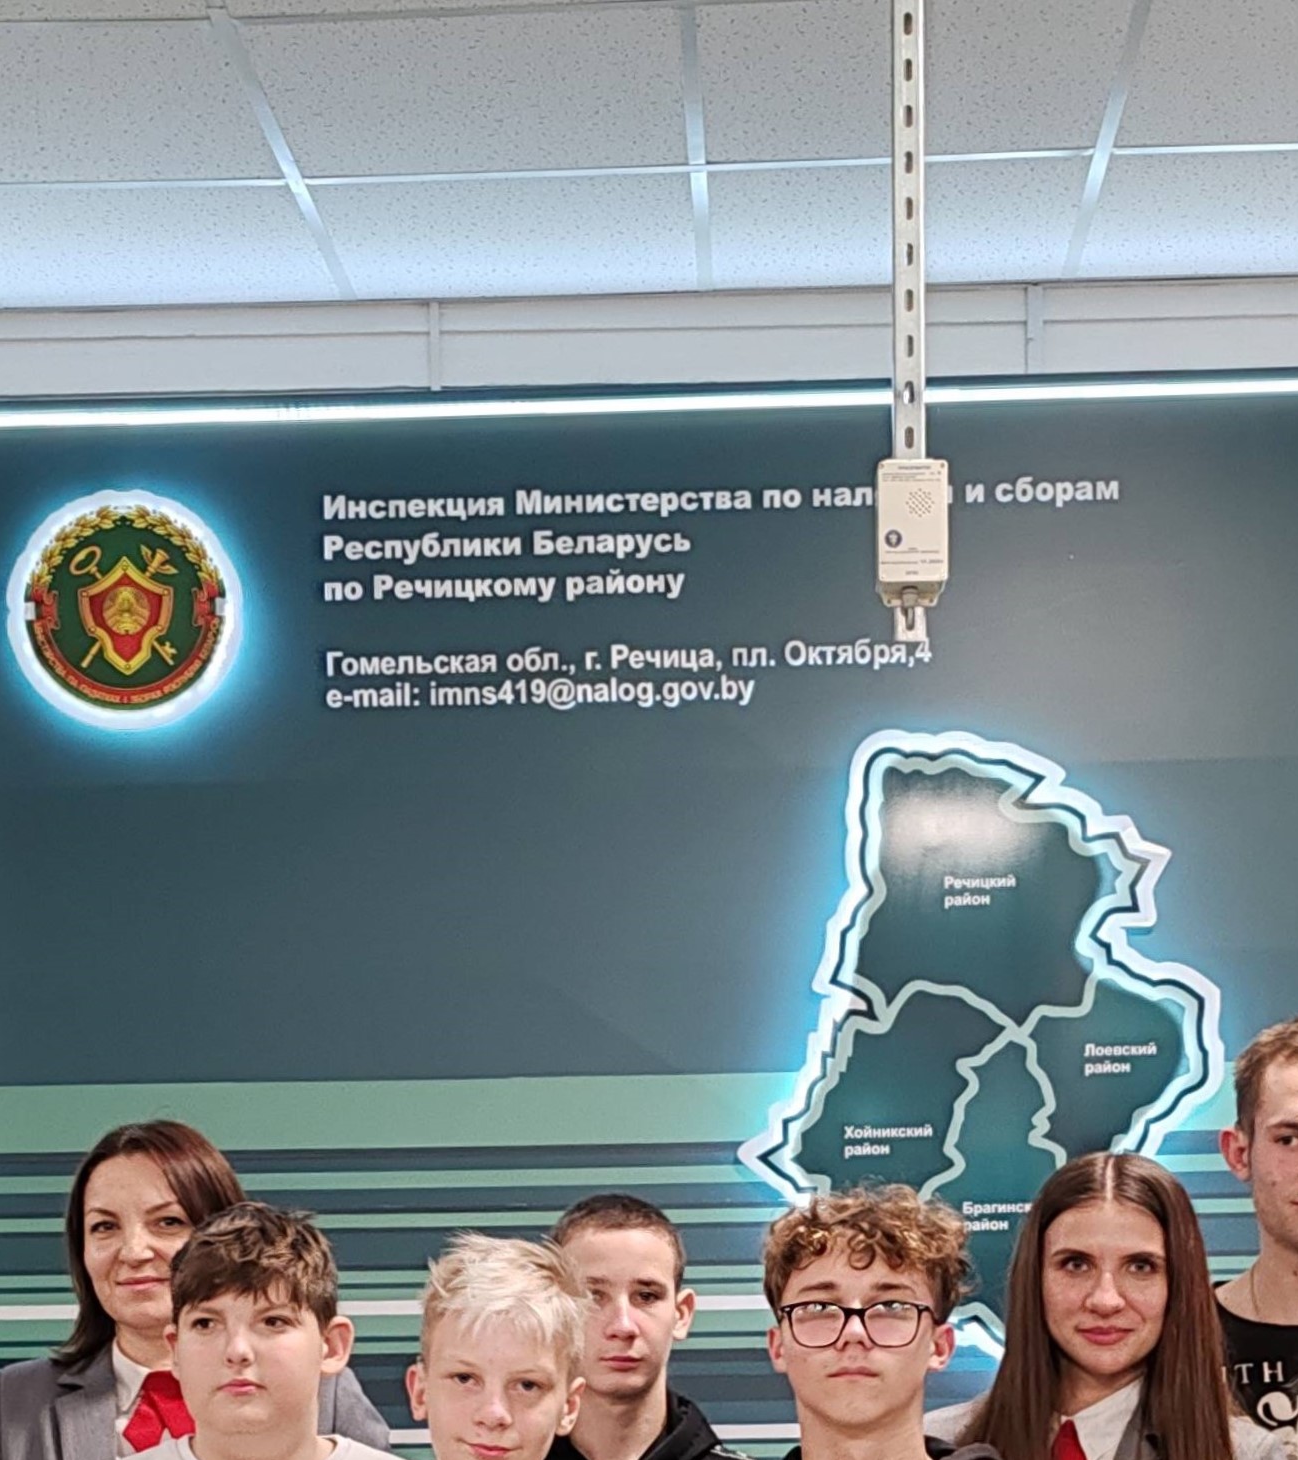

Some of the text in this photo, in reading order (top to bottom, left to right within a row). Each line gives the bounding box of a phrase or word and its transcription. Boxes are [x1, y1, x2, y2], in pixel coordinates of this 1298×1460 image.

[323, 494, 505, 521] Инспекция
[516, 489, 752, 518] Министерства
[763, 488, 802, 508] по
[966, 483, 985, 503] и
[995, 476, 1119, 508] сборам
[323, 529, 691, 566] Республики Беларусь
[324, 568, 686, 603] по Речицкому району
[326, 637, 933, 680] Гомельская обл., г. Речица, пл. Октября,4
[326, 675, 756, 711] e-mail: imns419@nalog.gov.by
[944, 874, 1016, 890] Речицкий
[944, 892, 991, 910] район
[1084, 1041, 1157, 1058] Лоевский
[1084, 1060, 1131, 1076] район
[844, 1123, 933, 1140] Хойникский
[844, 1142, 890, 1159] район
